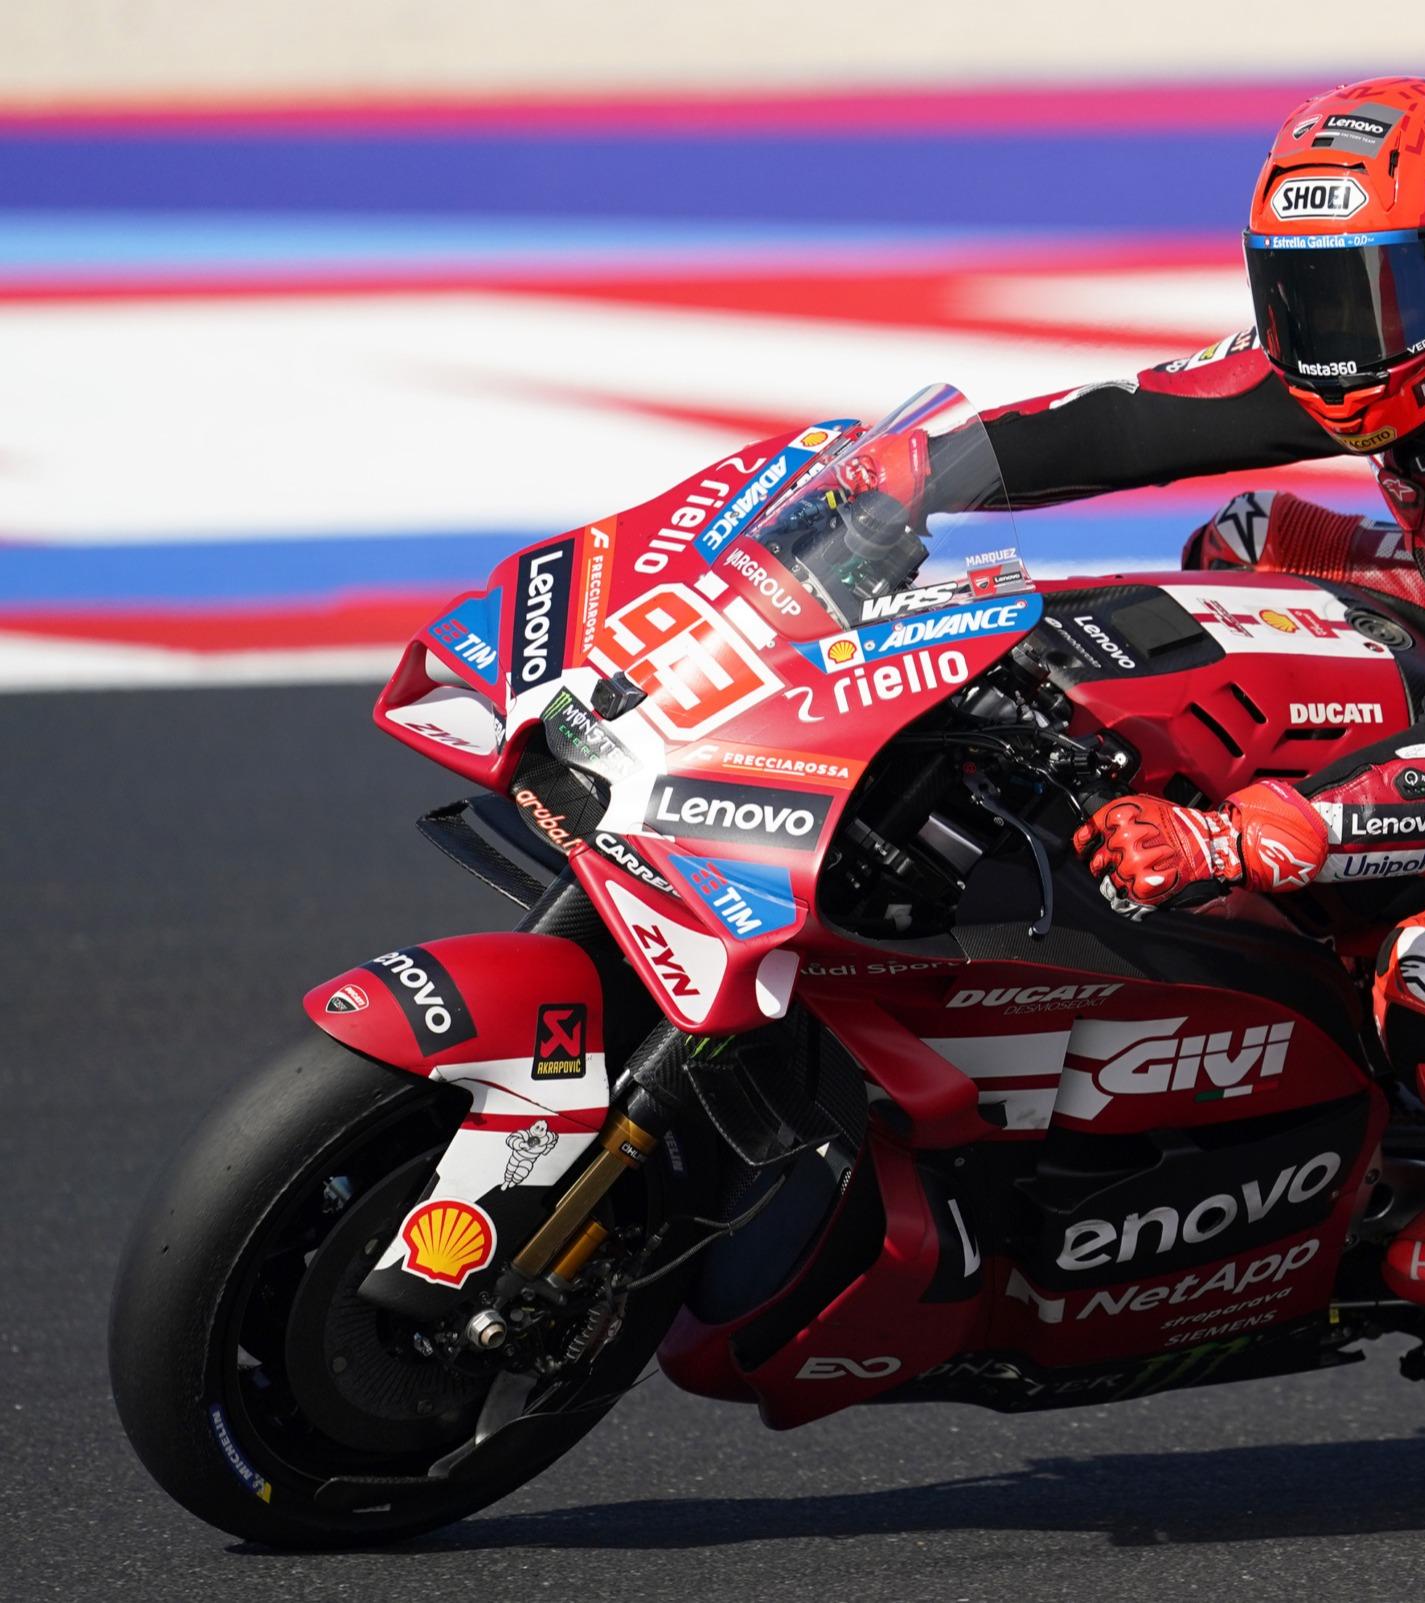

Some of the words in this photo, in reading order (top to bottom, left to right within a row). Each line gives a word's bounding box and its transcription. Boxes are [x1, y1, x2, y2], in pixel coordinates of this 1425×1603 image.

[1328, 116, 1384, 134] Lenovo
[1282, 186, 1351, 211] SHOEI
[1273, 235, 1308, 248] Estrella
[1307, 233, 1346, 248] Galicia
[1298, 361, 1357, 376] Insta360
[702, 455, 787, 551] ADVANCE
[634, 479, 730, 574] riello
[965, 548, 1017, 567] MARQUEZ
[522, 550, 563, 682] Lenovo
[582, 555, 603, 653] FRECCIAROSSA
[861, 582, 956, 621] WRS
[454, 633, 498, 670] TIM
[878, 607, 1019, 652] ADVANCE
[1074, 616, 1135, 669] Lenovo
[834, 650, 969, 714] riello
[1290, 703, 1384, 724] DUCATI
[723, 752, 849, 779] FRECCIAROSSA
[656, 786, 815, 836] Lenovo
[714, 887, 763, 935] TIM
[632, 924, 700, 998] ZYN
[373, 952, 452, 1034] enovo
[945, 983, 1126, 1008] DUCATI
[1099, 1020, 1295, 1095] GIVI
[1075, 1238, 1321, 1321] NetApp
[1160, 1287, 1293, 1330] streparava
[1168, 1310, 1278, 1347] SIEMENS
